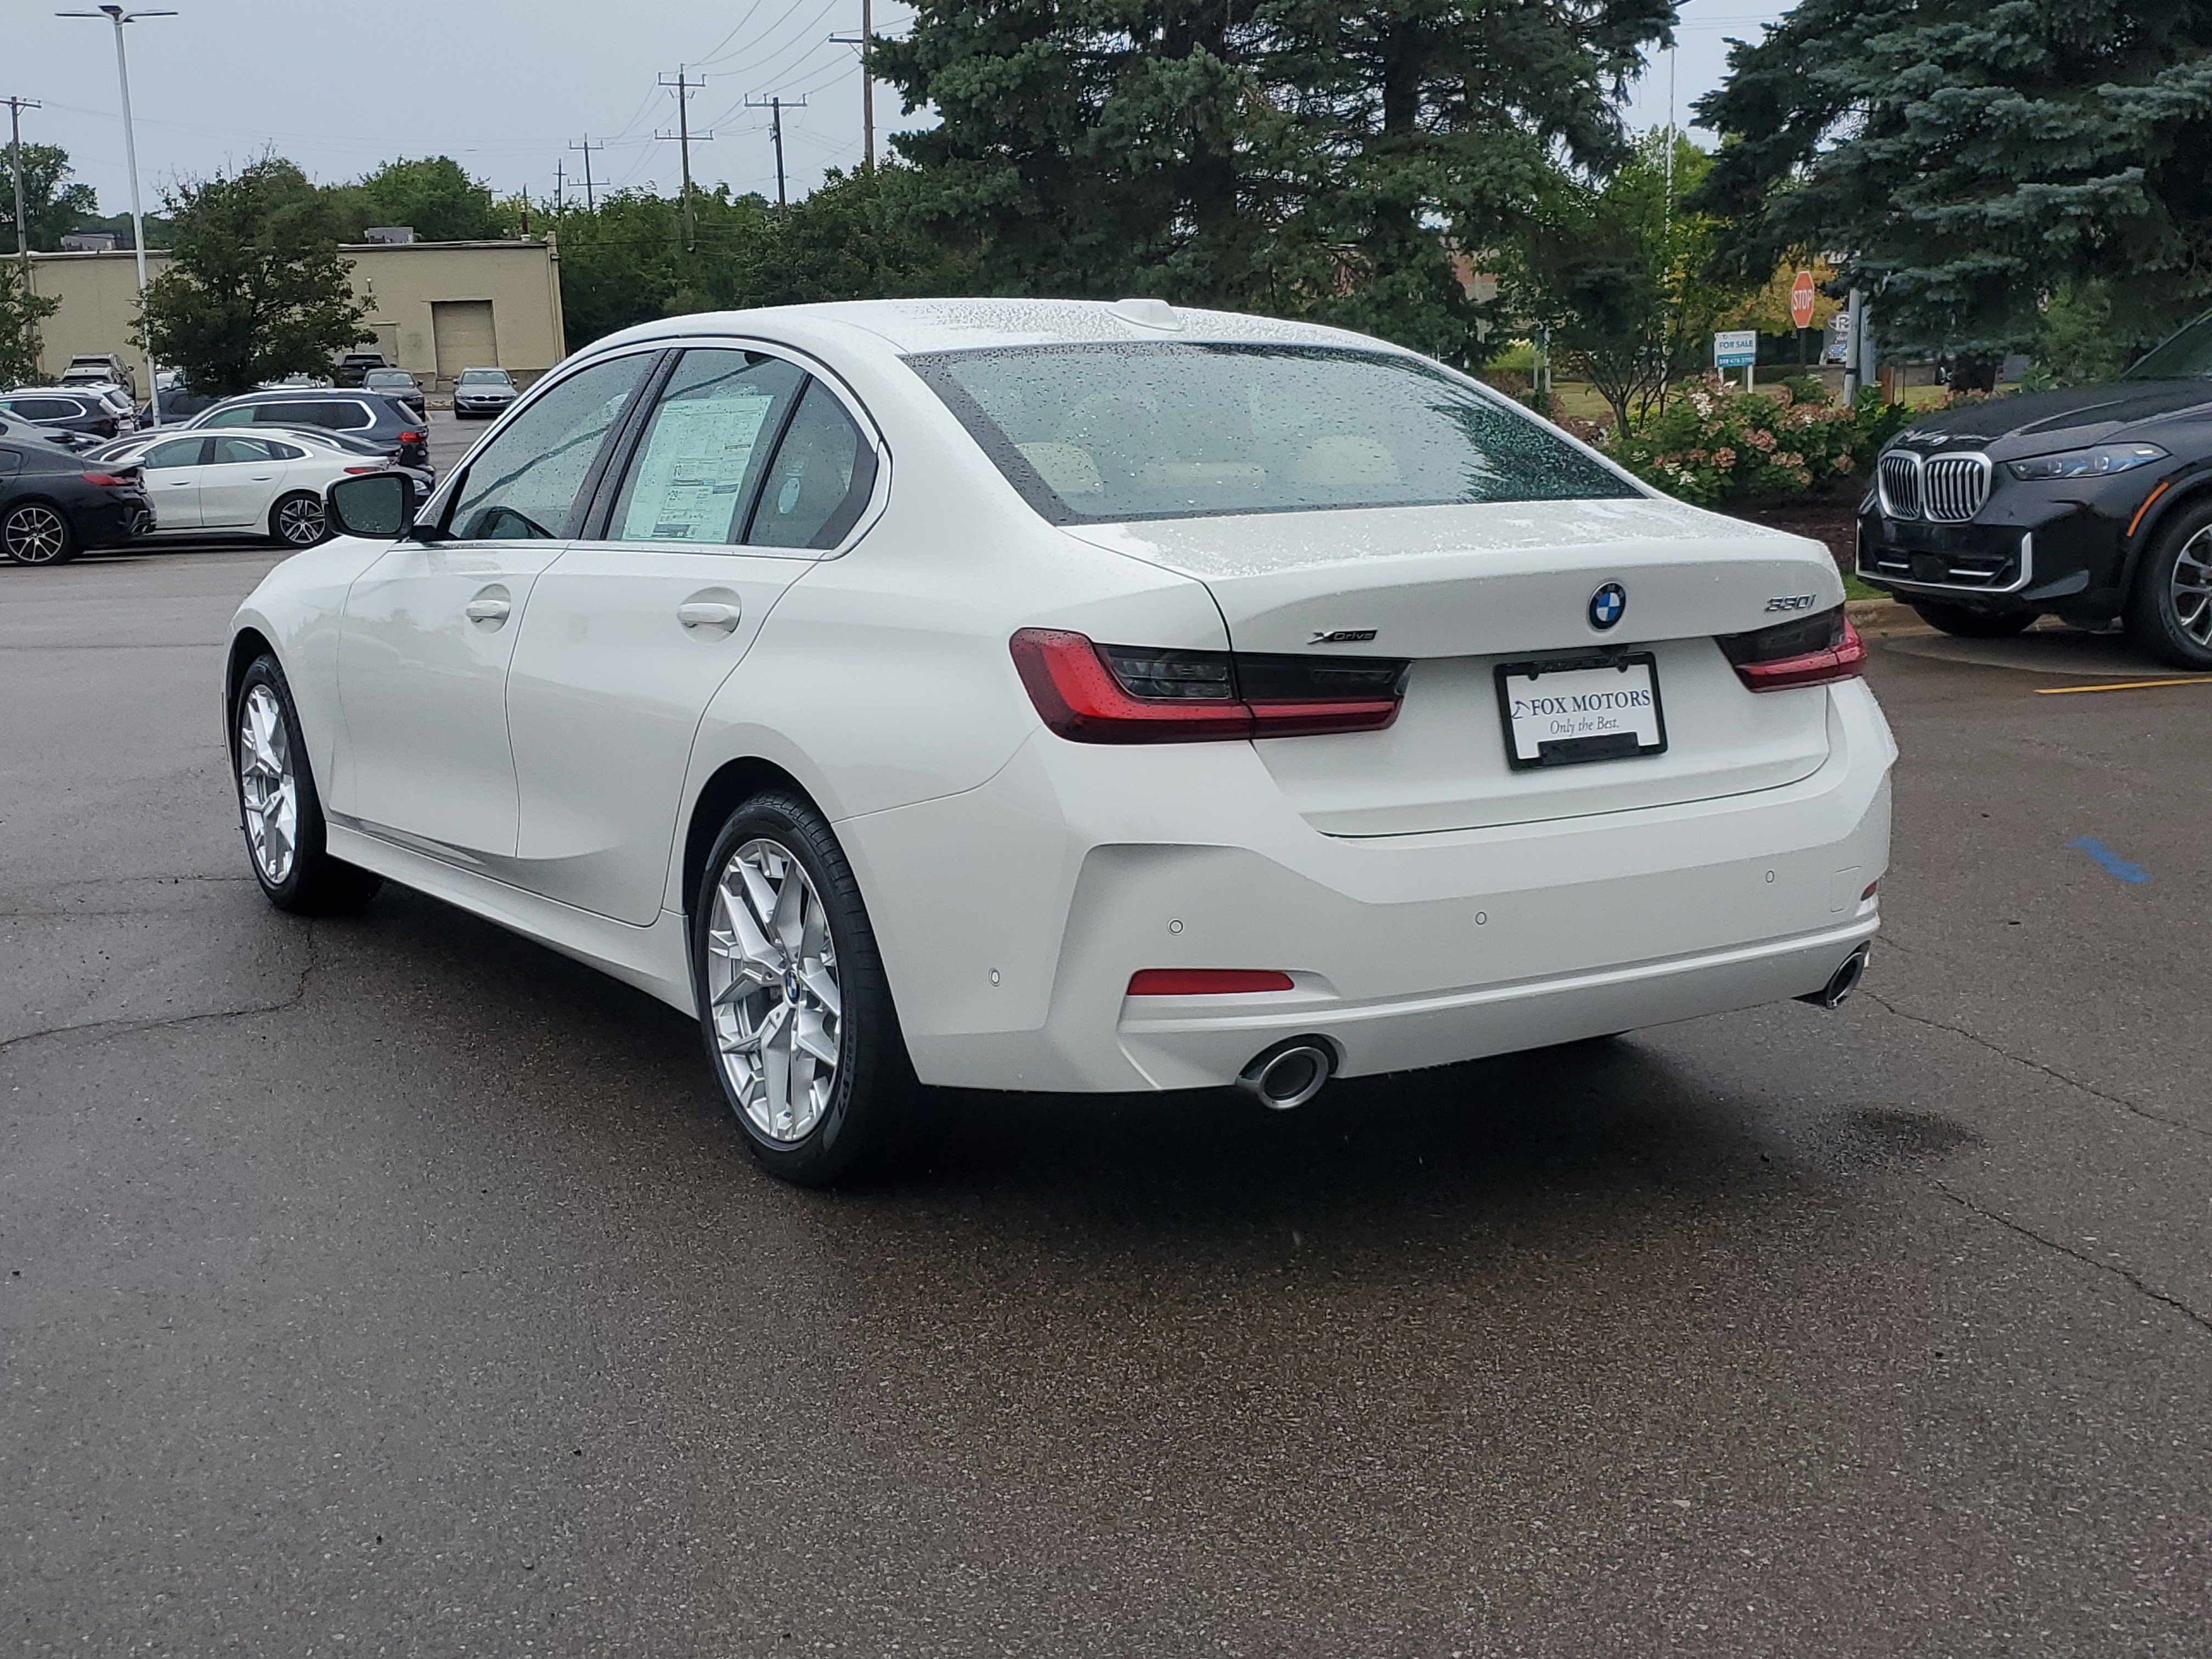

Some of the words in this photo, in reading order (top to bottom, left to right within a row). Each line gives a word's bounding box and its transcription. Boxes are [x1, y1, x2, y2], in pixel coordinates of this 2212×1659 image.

[1793, 289, 1813, 311] STOP
[1736, 340, 1753, 348] SALE
[1529, 697, 1568, 716] FOX
[1571, 690, 1651, 712] MOTORS
[1550, 718, 1575, 737] Only
[1578, 717, 1593, 731] the
[1597, 716, 1620, 730] Best.
